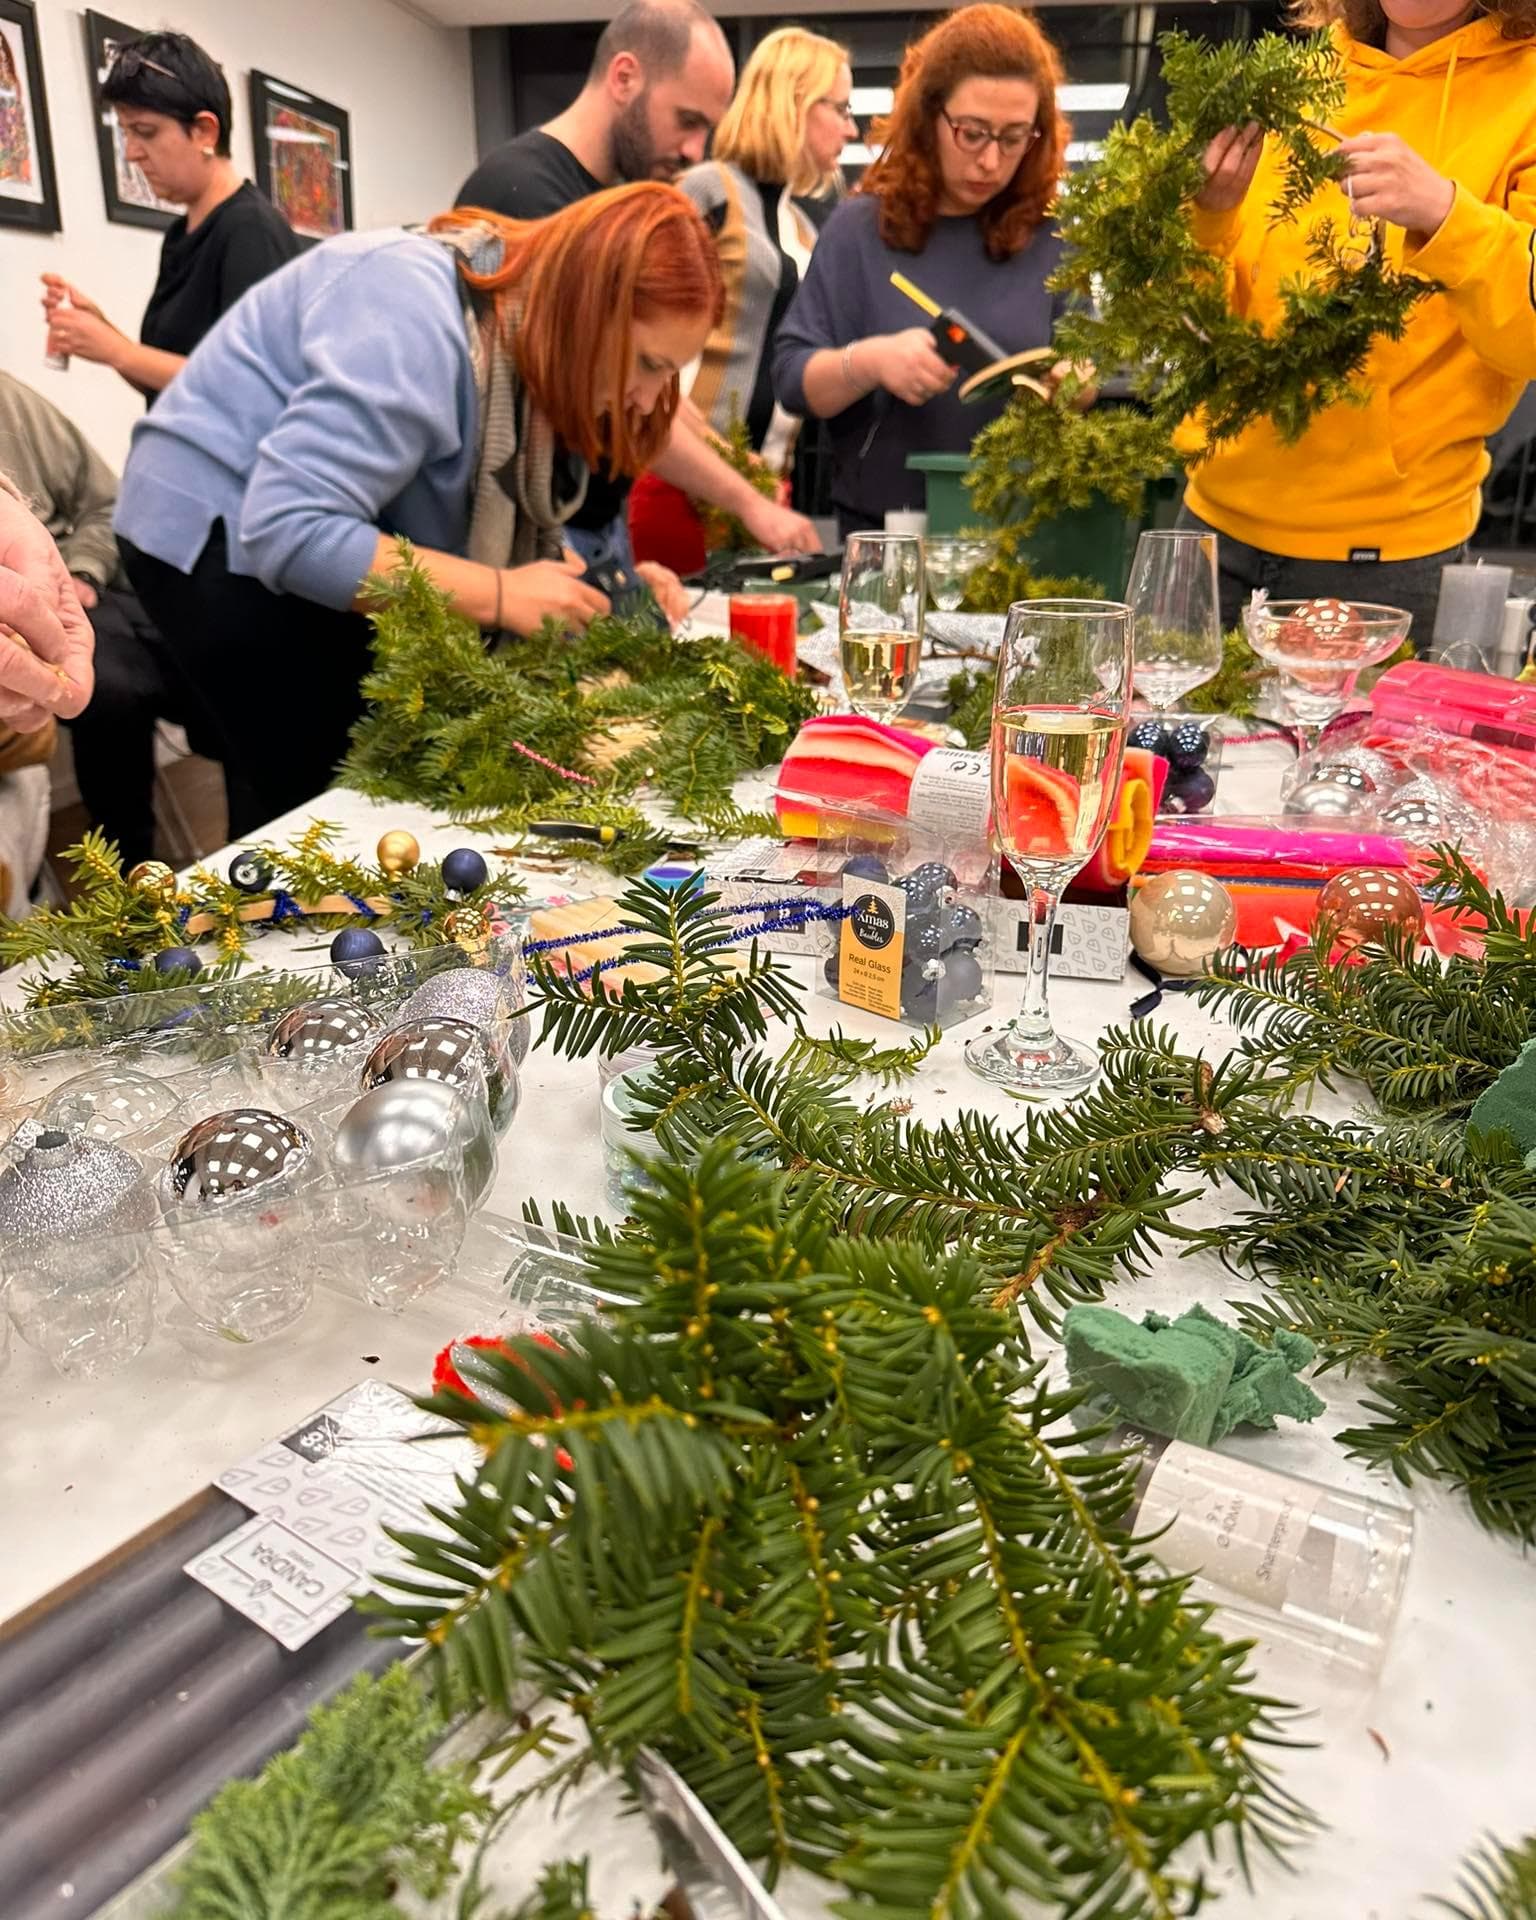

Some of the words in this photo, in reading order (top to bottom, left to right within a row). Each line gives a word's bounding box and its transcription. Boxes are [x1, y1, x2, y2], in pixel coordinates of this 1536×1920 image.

[857, 910, 889, 929] Xmas
[848, 953, 867, 966] Real
[868, 959, 891, 974] Glass
[250, 1541, 325, 1597] CANDRA
